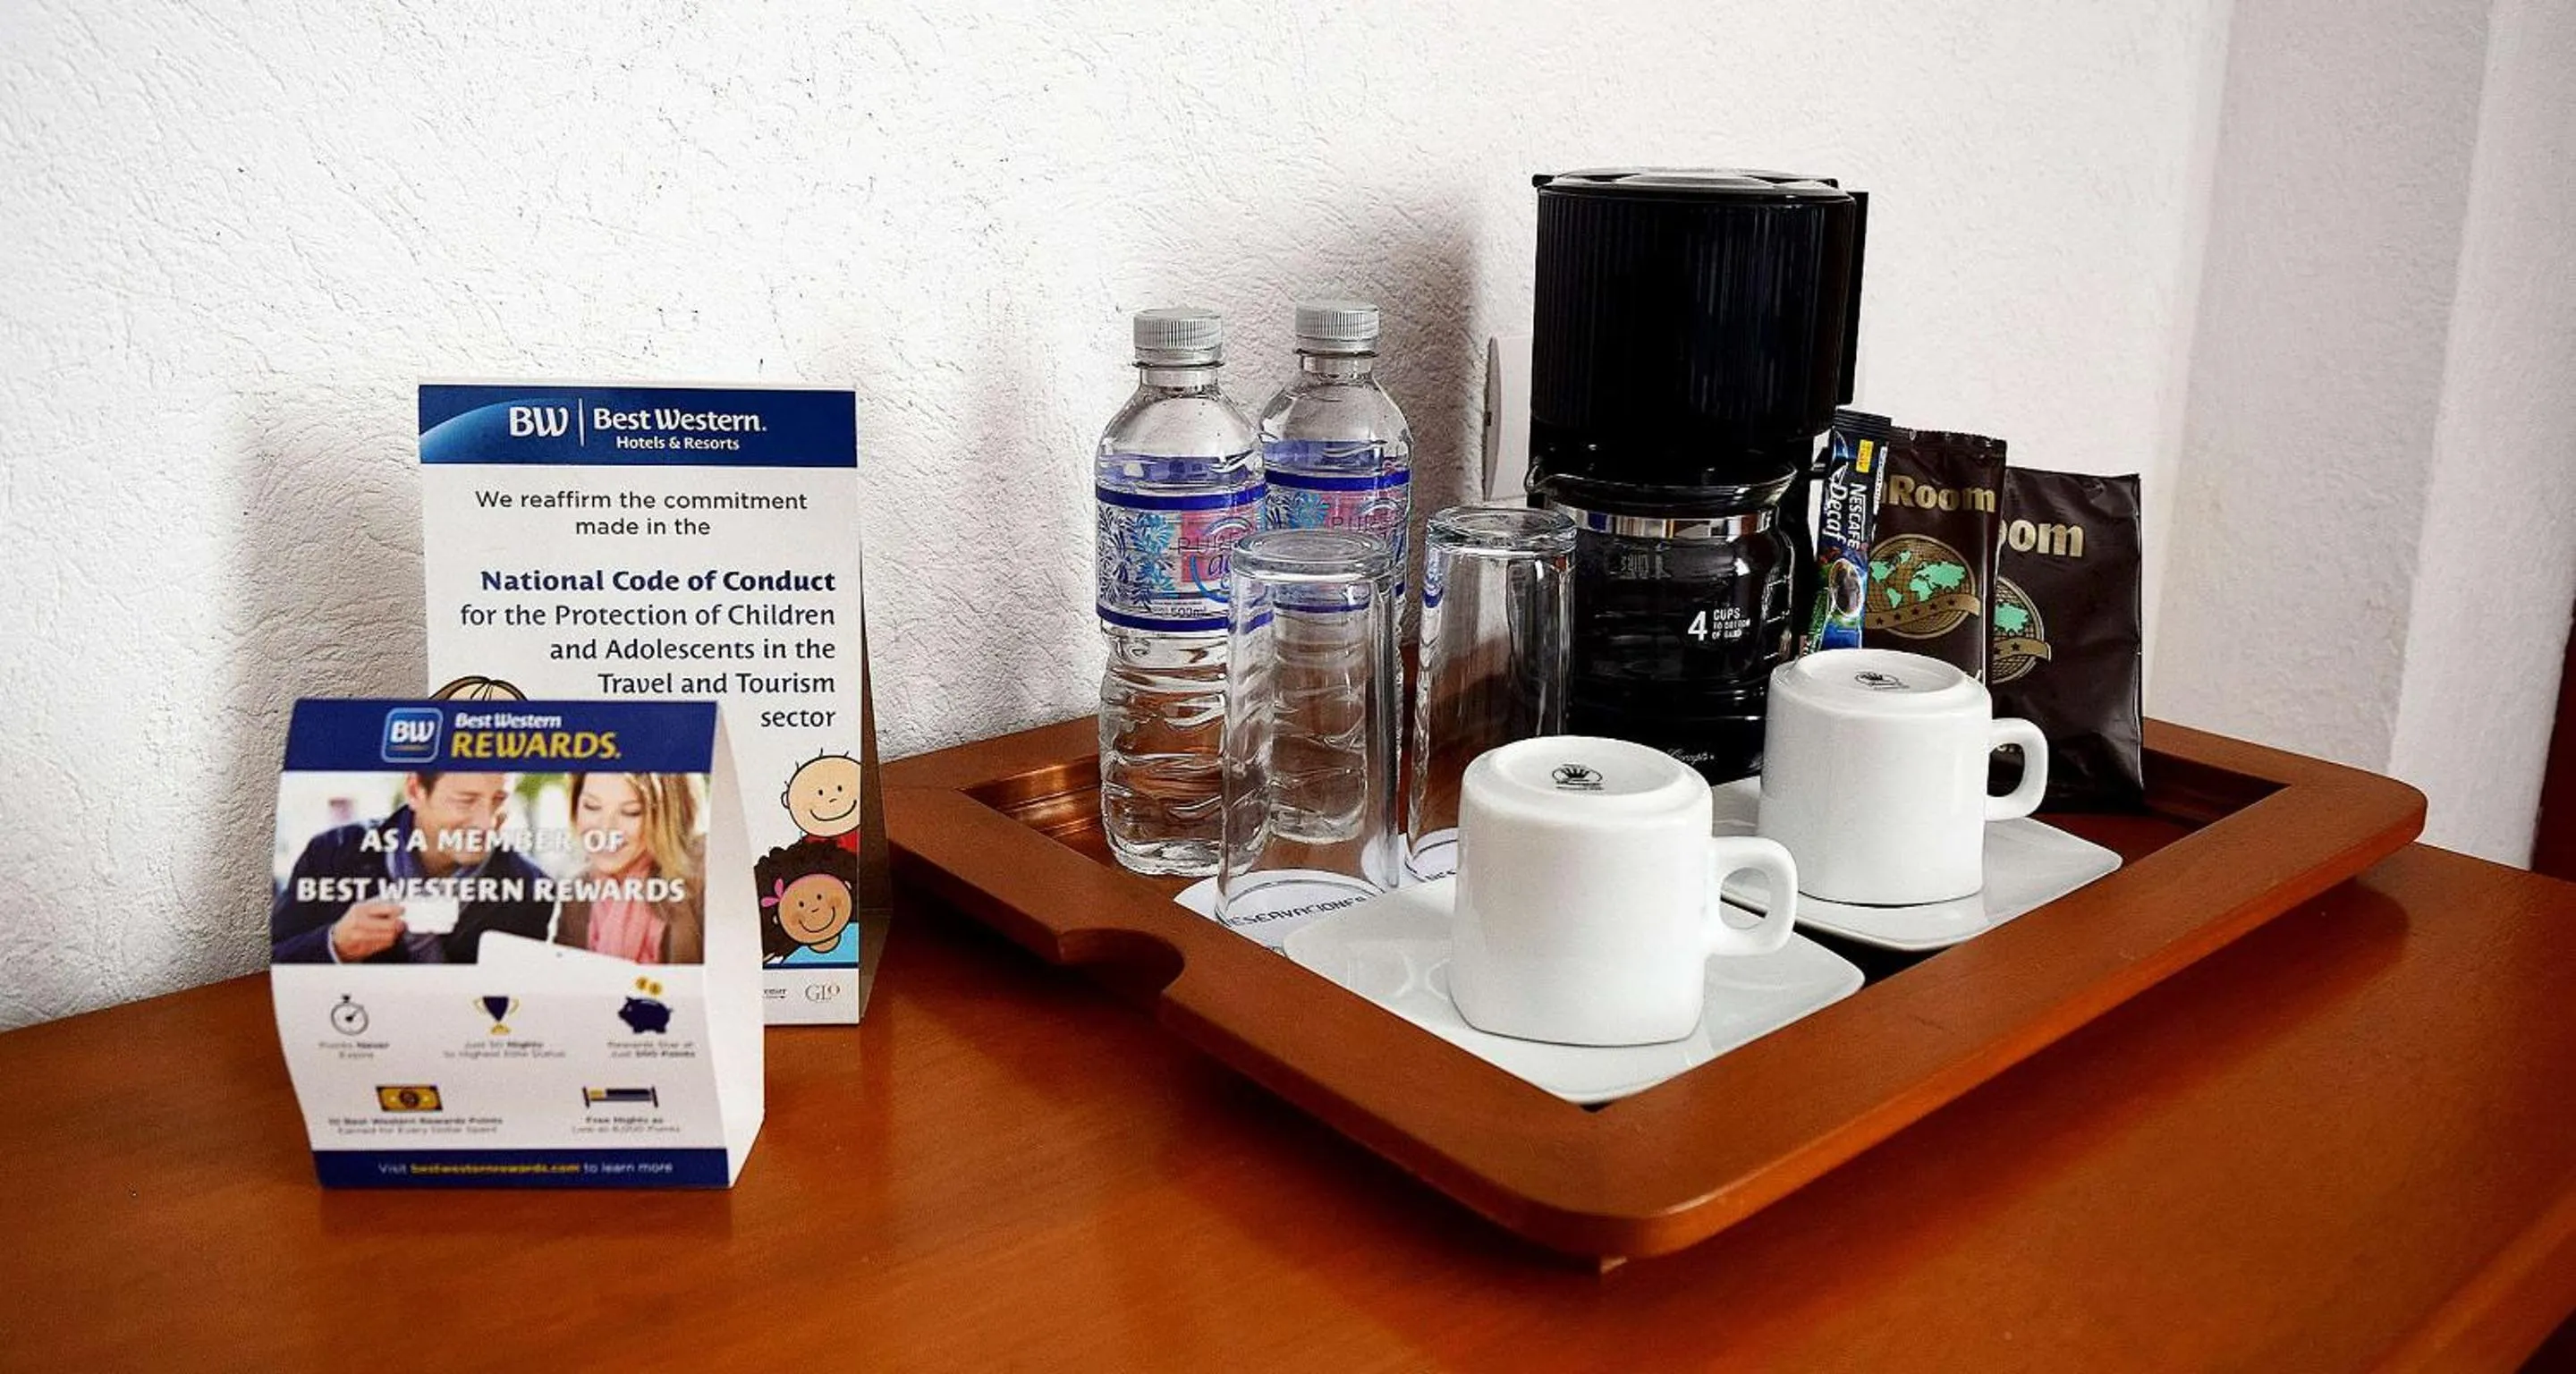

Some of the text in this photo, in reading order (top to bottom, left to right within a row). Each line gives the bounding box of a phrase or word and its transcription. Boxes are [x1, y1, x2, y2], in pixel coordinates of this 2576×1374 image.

[509, 406, 569, 437] BW
[593, 408, 652, 430] Best
[616, 436, 741, 451] Hotels & Resorts
[475, 490, 808, 510] We reaffirm the commitment
[1880, 474, 1996, 513] Room
[1822, 467, 1849, 545] Decaf
[576, 517, 711, 536] made in the
[480, 569, 836, 592] National Code of Conduct
[461, 604, 835, 626] for the Protection of Children
[1687, 606, 1741, 641] 4 CUPS
[550, 638, 835, 660] and Adolescents in the
[597, 672, 835, 694] Travel and Tourism
[454, 712, 562, 729] Best Western
[761, 710, 836, 727] sector
[390, 720, 435, 742] BW
[360, 828, 626, 852] AS A MEMBER OF
[296, 878, 686, 903] BEST WESTERN REWARDS
[378, 1162, 407, 1174] Visit
[583, 1162, 597, 1174] to
[601, 1162, 635, 1174] learn
[638, 1163, 674, 1174] more
